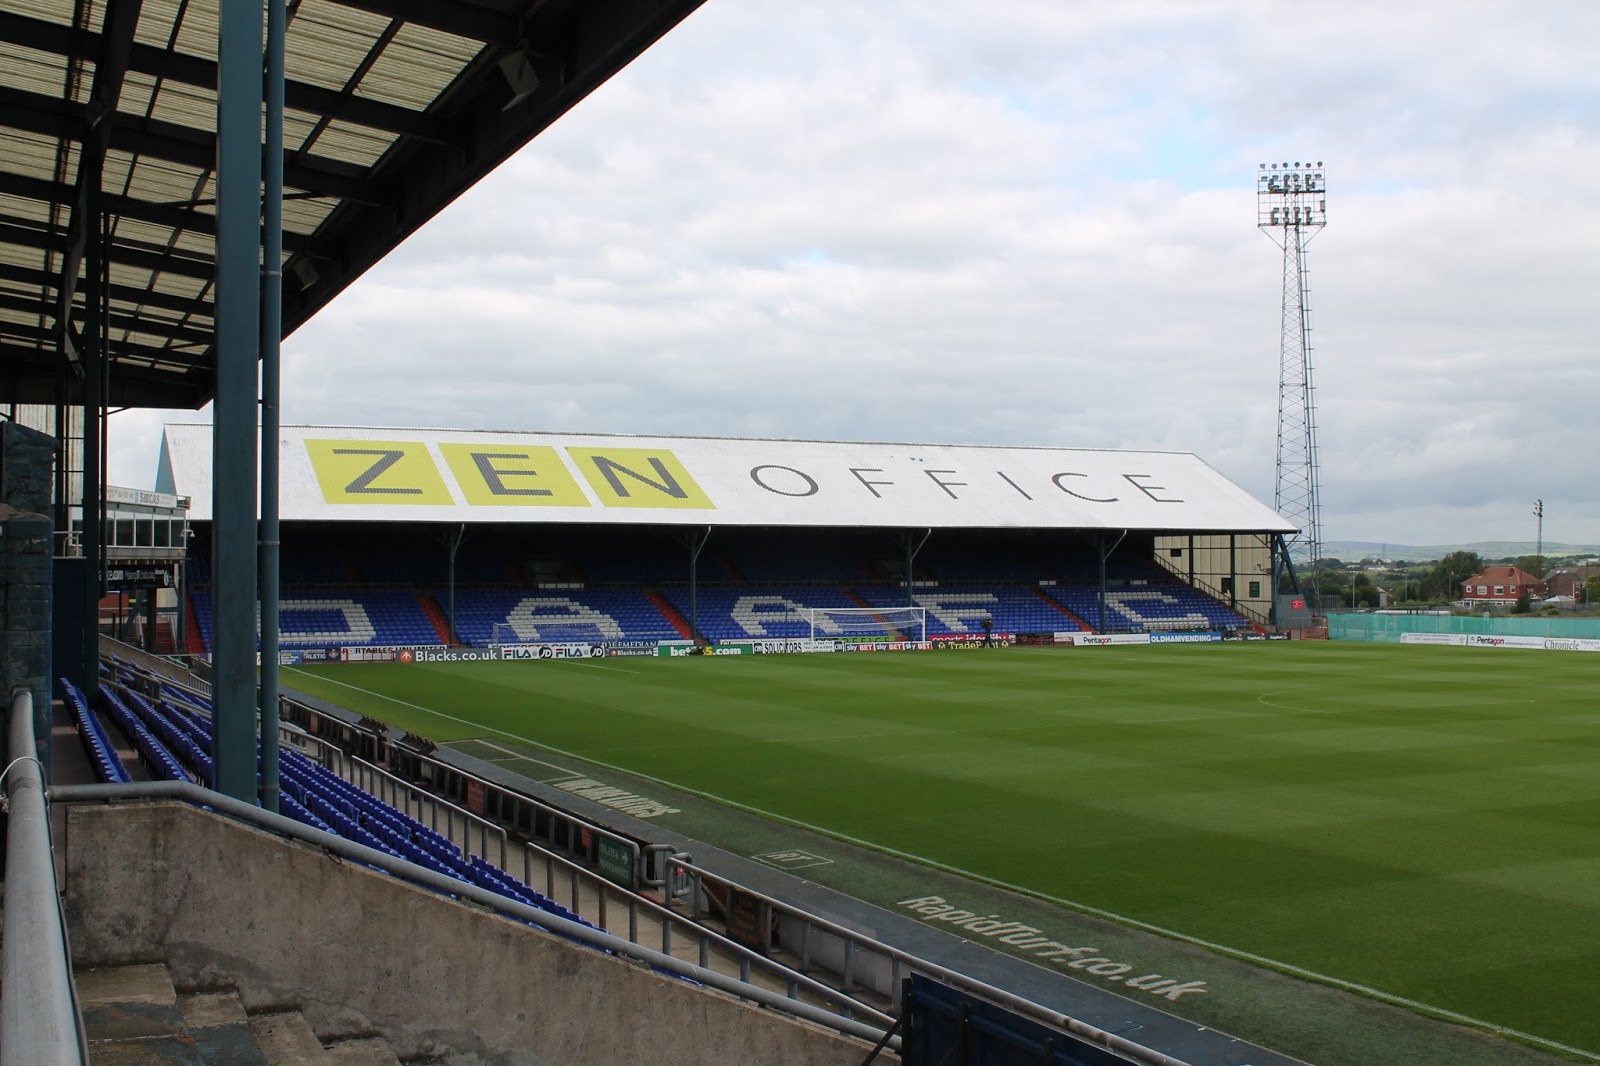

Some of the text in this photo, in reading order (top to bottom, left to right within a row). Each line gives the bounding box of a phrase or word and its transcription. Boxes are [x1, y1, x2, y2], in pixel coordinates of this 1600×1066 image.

[333, 449, 1184, 503] ZEN OFFICE
[1083, 637, 1112, 646] Pentagon
[1476, 636, 1505, 646] Pentagon
[1544, 638, 1580, 650] Chronicle
[670, 646, 742, 657] bet5.com
[859, 643, 873, 651] BET
[415, 650, 498, 662] Blacks.co.uk
[503, 650, 532, 659] FILA
[556, 648, 583, 657] FILA
[897, 895, 1207, 1001] RapidTurf.co.uk
